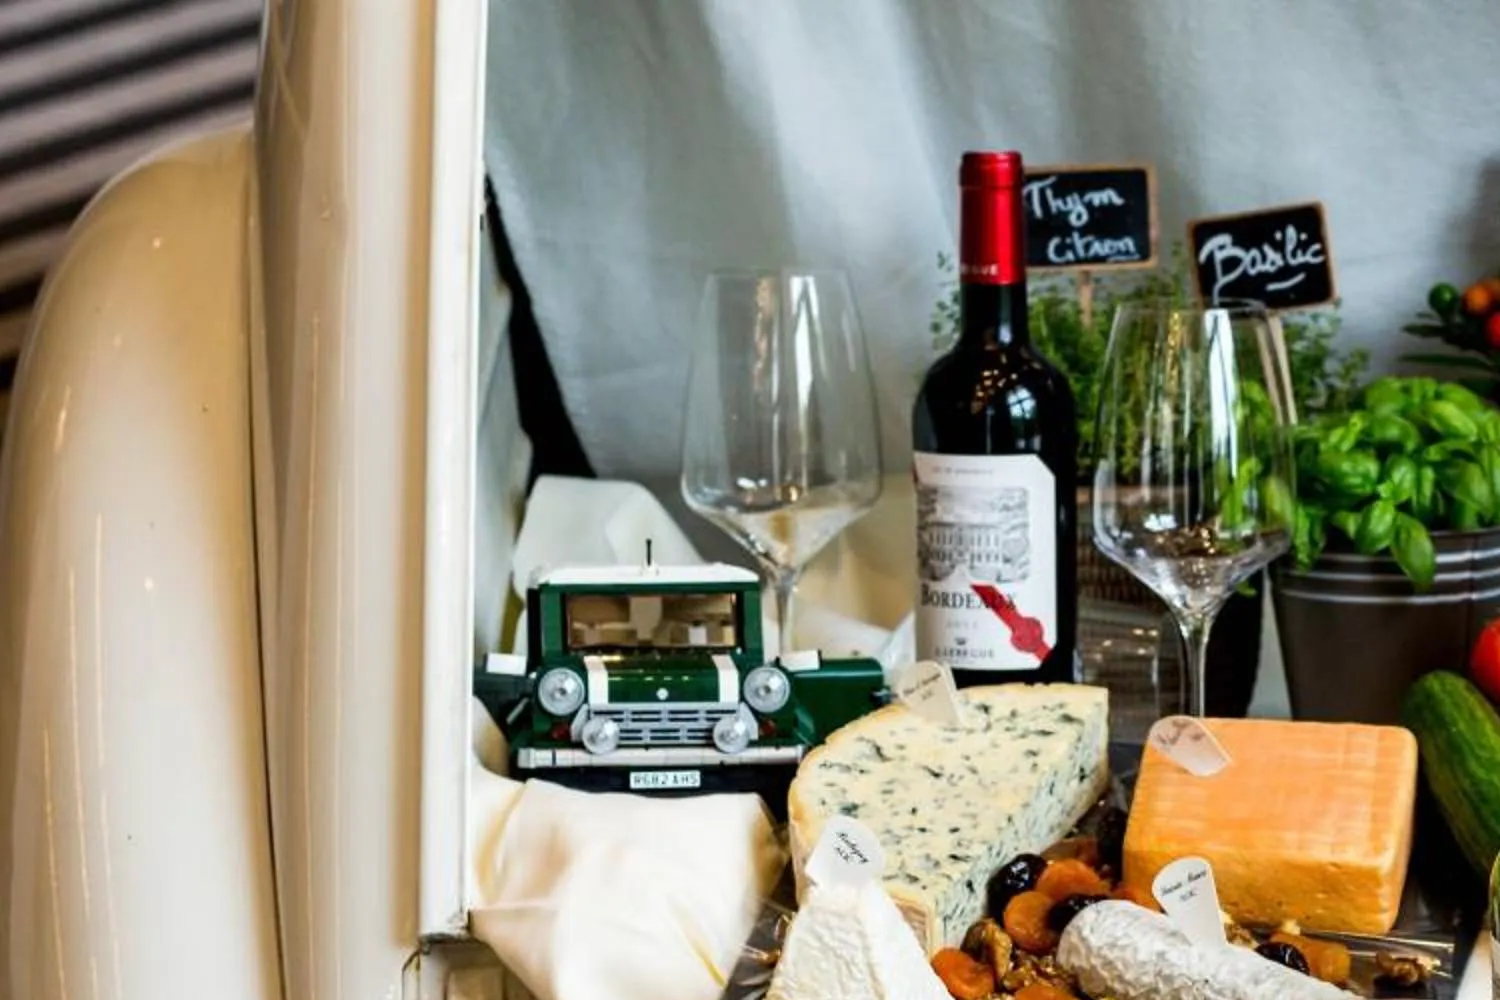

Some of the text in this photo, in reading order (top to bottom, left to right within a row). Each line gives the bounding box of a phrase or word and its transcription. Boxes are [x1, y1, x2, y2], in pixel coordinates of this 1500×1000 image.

[1022, 176, 1125, 227] Thym
[1047, 231, 1136, 263] Citron
[1199, 224, 1325, 306] Basilic
